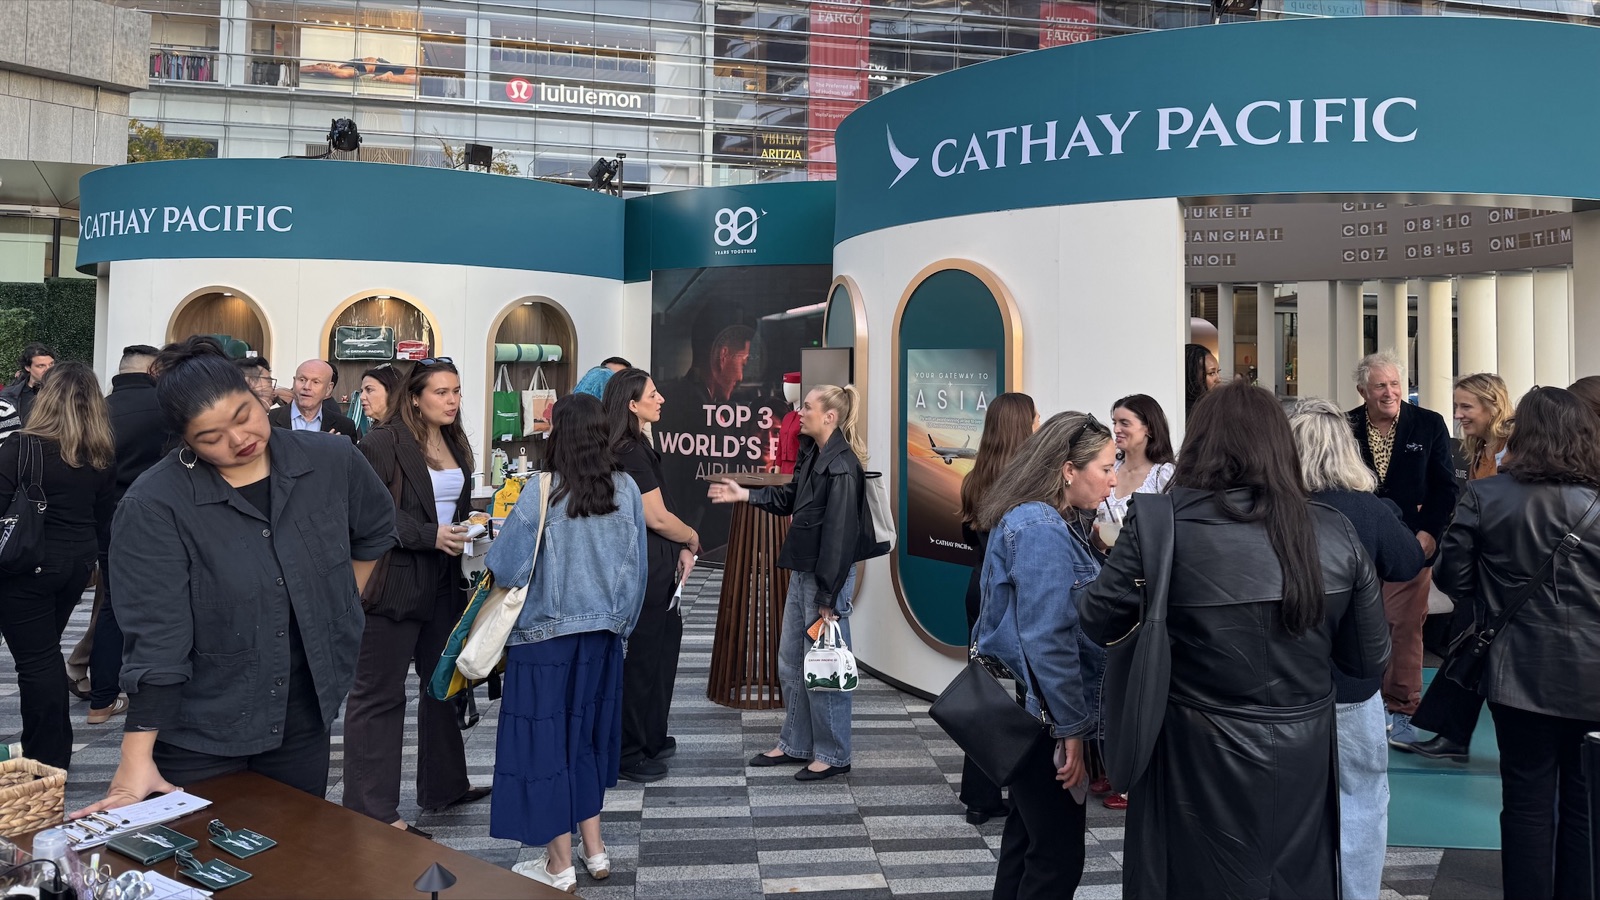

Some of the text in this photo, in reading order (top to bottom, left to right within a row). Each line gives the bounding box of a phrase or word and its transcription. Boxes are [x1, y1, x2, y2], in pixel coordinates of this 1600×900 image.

[817, 12, 863, 25] FARGO
[1290, 1, 1358, 15] queesyard
[1046, 31, 1089, 43] FARGO
[541, 82, 642, 109] lululemon
[931, 97, 1418, 178] CATHAY PACIFIC
[761, 148, 802, 160] ARITZIA
[84, 205, 293, 240] CATHAY PACIFIC
[714, 206, 758, 247] 80
[1184, 207, 1514, 236] UKET C01 08:10 ON
[1184, 229, 1278, 241] ANGHAI
[1343, 249, 1385, 262] C07
[1407, 242, 1470, 258] 08:45
[1490, 236, 1515, 250] ON
[1185, 255, 1231, 265] NOI
[915, 388, 988, 411] ASIA
[702, 404, 773, 430] TOP 3
[658, 431, 762, 460] WORLD'S
[935, 539, 954, 548] CATHAY
